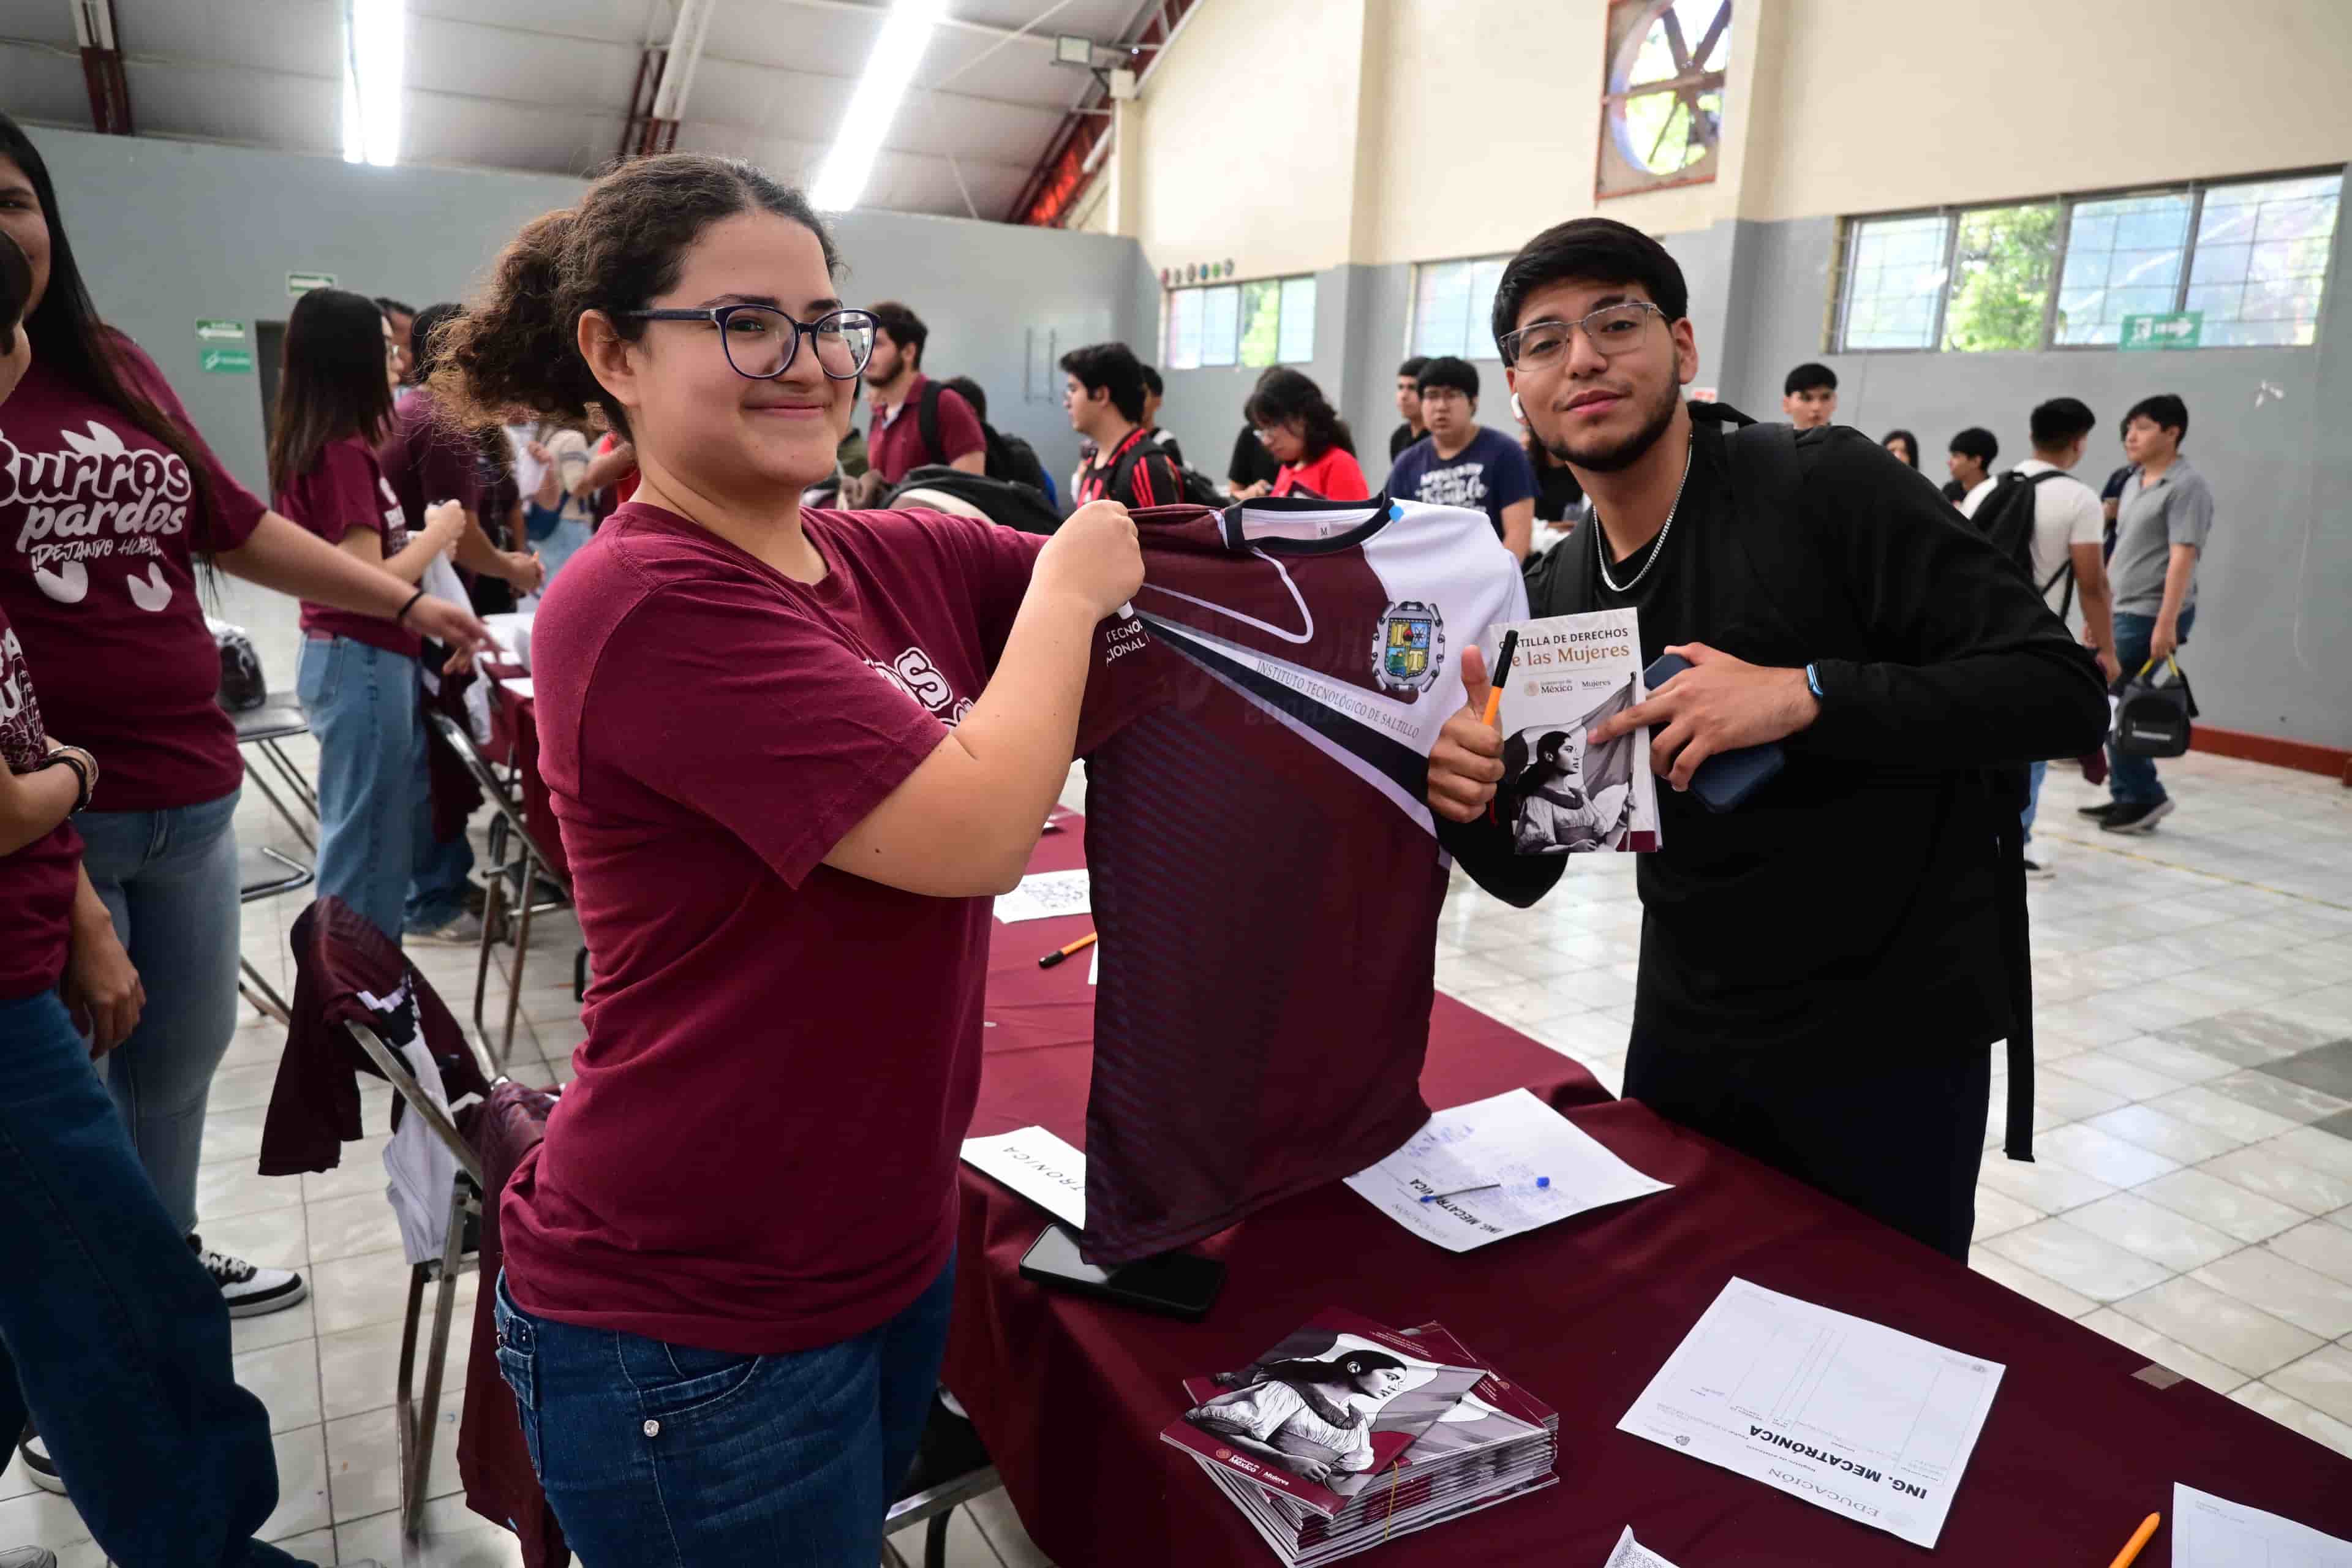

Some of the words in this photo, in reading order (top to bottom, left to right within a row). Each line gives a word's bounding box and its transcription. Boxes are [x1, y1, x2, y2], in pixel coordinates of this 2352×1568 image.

[16, 488, 186, 552] pardos
[1499, 636, 1550, 649] CTILLA
[1553, 635, 1567, 644] DE
[1570, 628, 1629, 642] DERECHOS
[1528, 651, 1552, 666] las
[1558, 644, 1630, 664] Mujeres
[1257, 660, 1305, 689] INSTITUTO
[1306, 681, 1368, 715] TECNOLÓGICO
[1367, 707, 1380, 722] DE
[1381, 713, 1420, 739] SALTILLO
[1749, 1425, 1882, 1483] MECATRÓNICA
[1768, 1468, 1880, 1518] EDUCACIÓN
[1888, 1476, 1928, 1500] ING.
